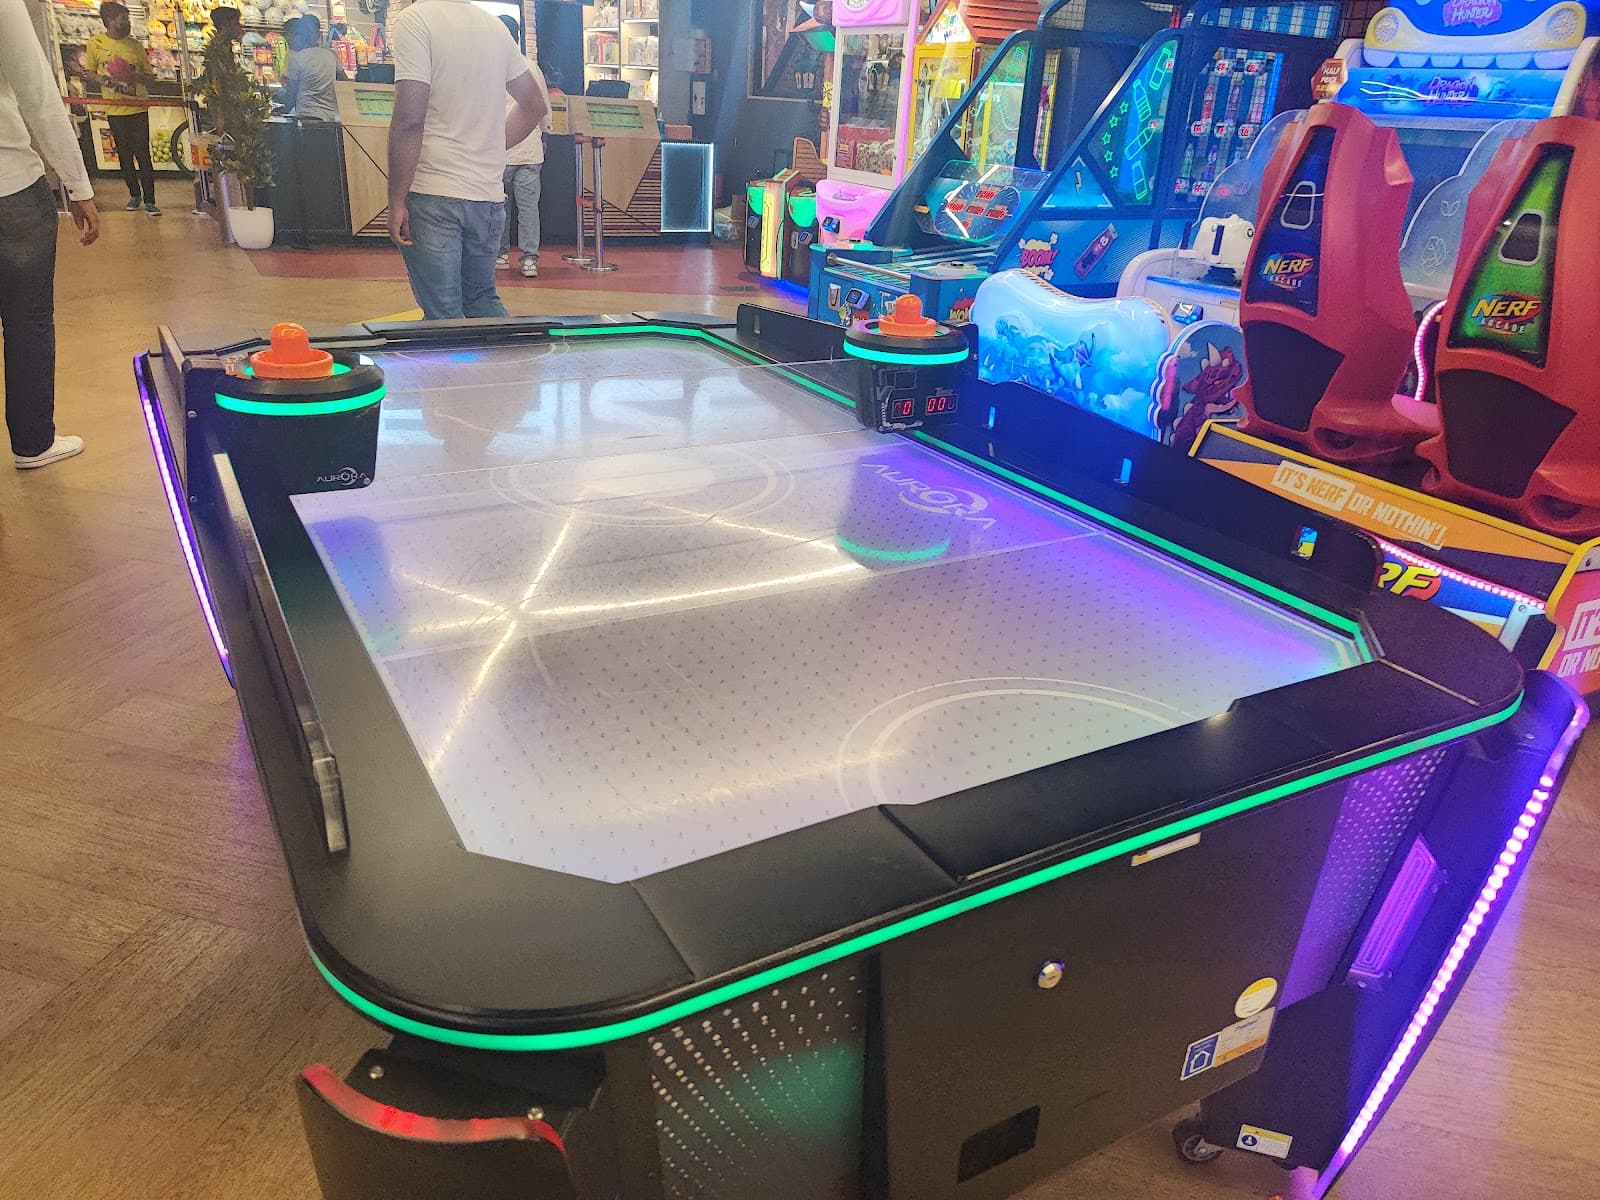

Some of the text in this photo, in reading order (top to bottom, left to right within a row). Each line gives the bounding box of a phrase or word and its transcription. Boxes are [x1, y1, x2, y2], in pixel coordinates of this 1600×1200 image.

[1428, 76, 1476, 90] DRAGON
[1263, 258, 1313, 275] NERF
[1270, 274, 1303, 287] ARCADE
[1471, 298, 1541, 317] NERF
[1481, 318, 1526, 333] ARCADE
[316, 470, 369, 484] AURORA
[860, 463, 997, 530] AURORA
[1277, 467, 1448, 545] IT'S NERF OR NOTHIN'!
[1557, 650, 1583, 678] OR
